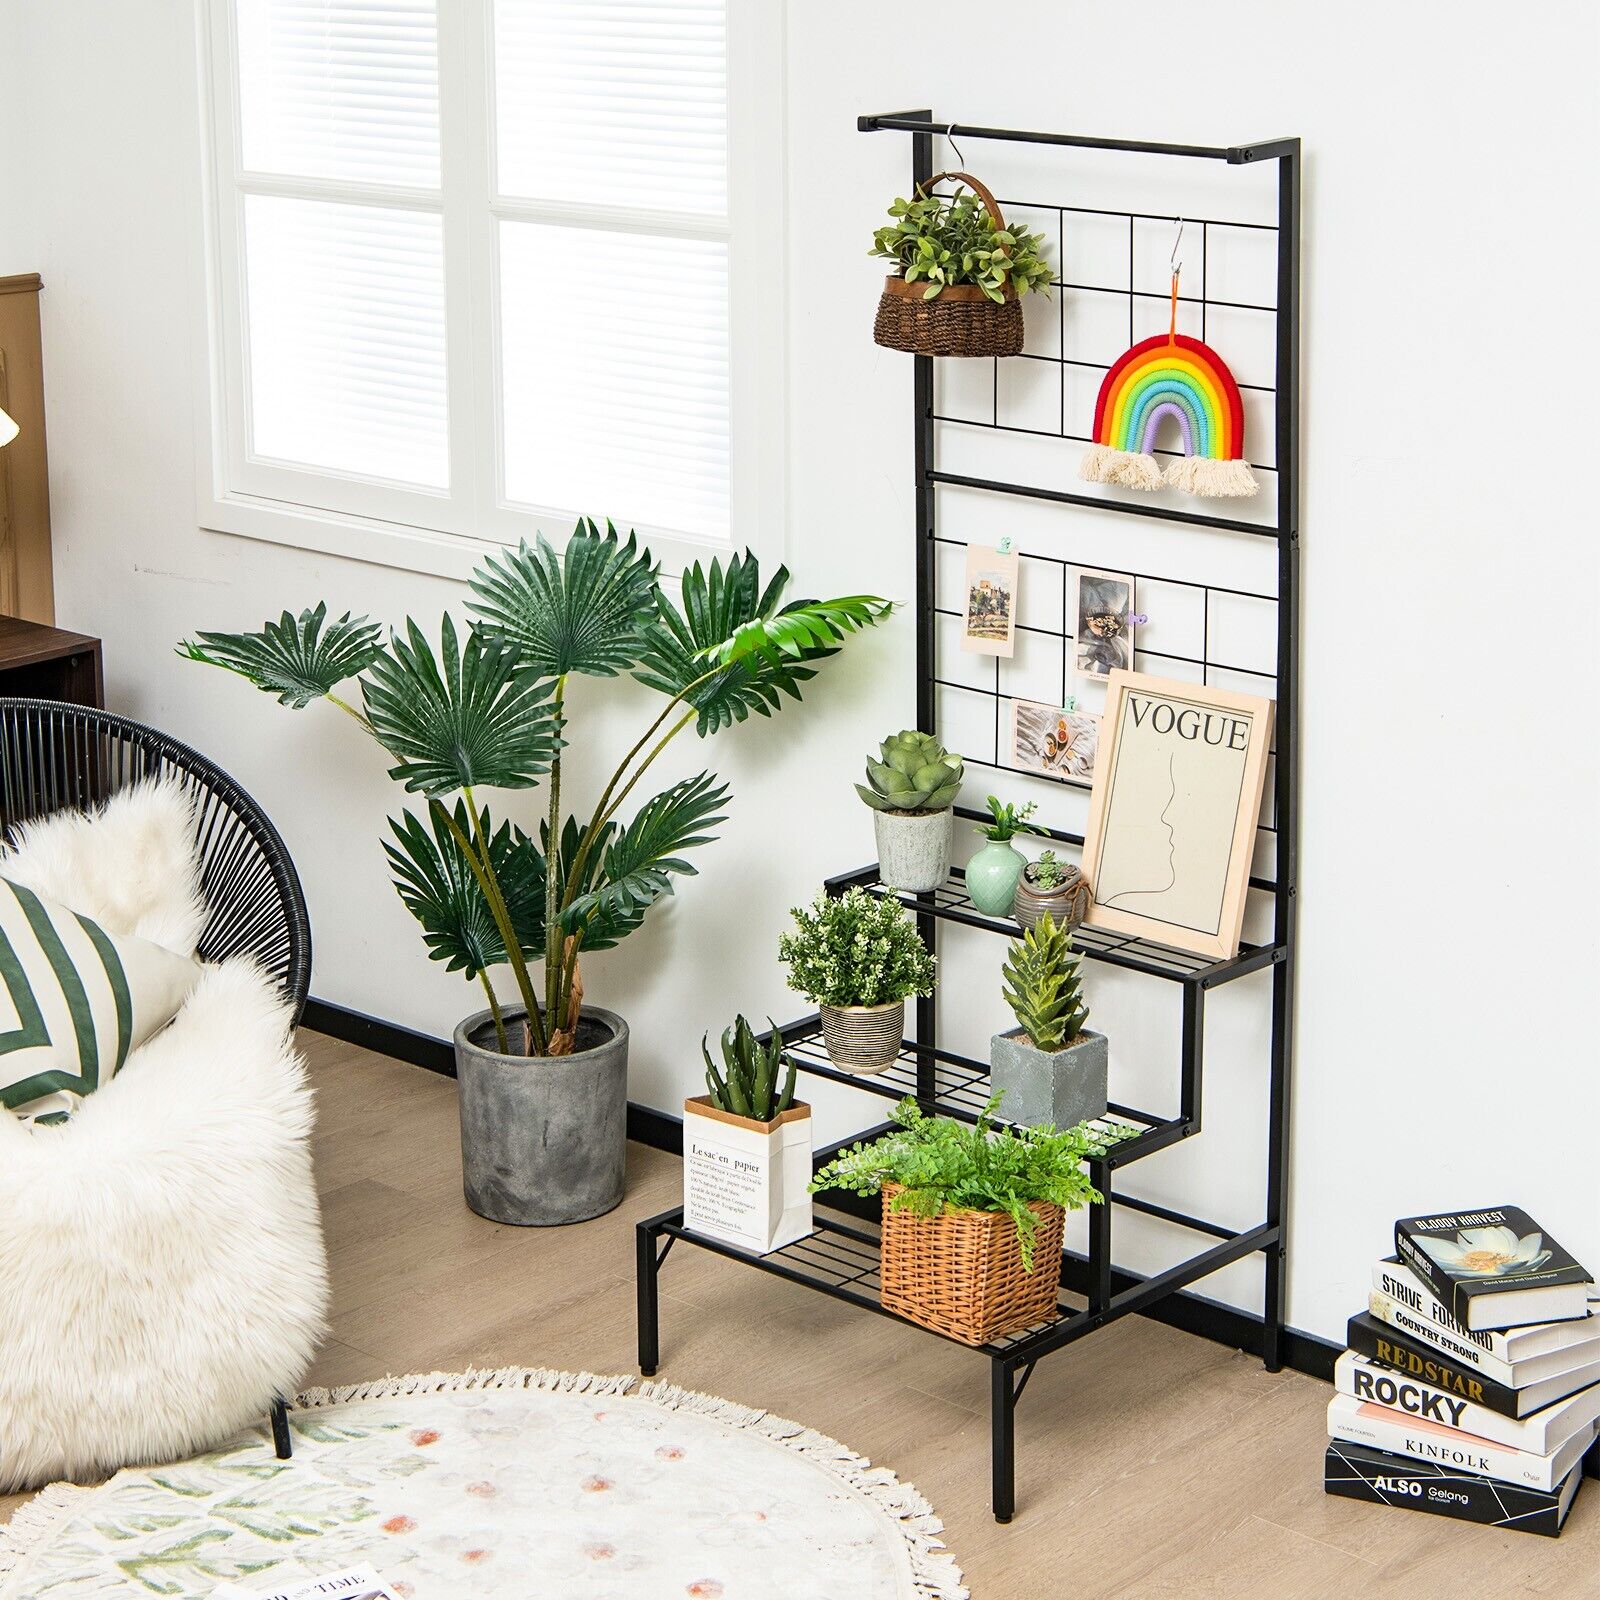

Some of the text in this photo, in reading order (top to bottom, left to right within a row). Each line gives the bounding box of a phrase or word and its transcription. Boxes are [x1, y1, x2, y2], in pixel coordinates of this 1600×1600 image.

[1130, 697, 1249, 752] VOGUE
[692, 1144, 703, 1156] Le
[718, 1155, 729, 1164] en
[734, 1160, 760, 1173] papier
[1415, 1216, 1458, 1231] BLOODY
[1457, 1210, 1507, 1226] HARVEST
[1382, 1273, 1423, 1313] STRIVE
[1395, 1310, 1480, 1365] COUNTRY STRONG
[1354, 1369, 1468, 1428] ROCKY
[1405, 1438, 1490, 1472] KINFOLK
[1374, 1475, 1469, 1505] ALSO Gelang
[314, 1574, 365, 1593] TIME
